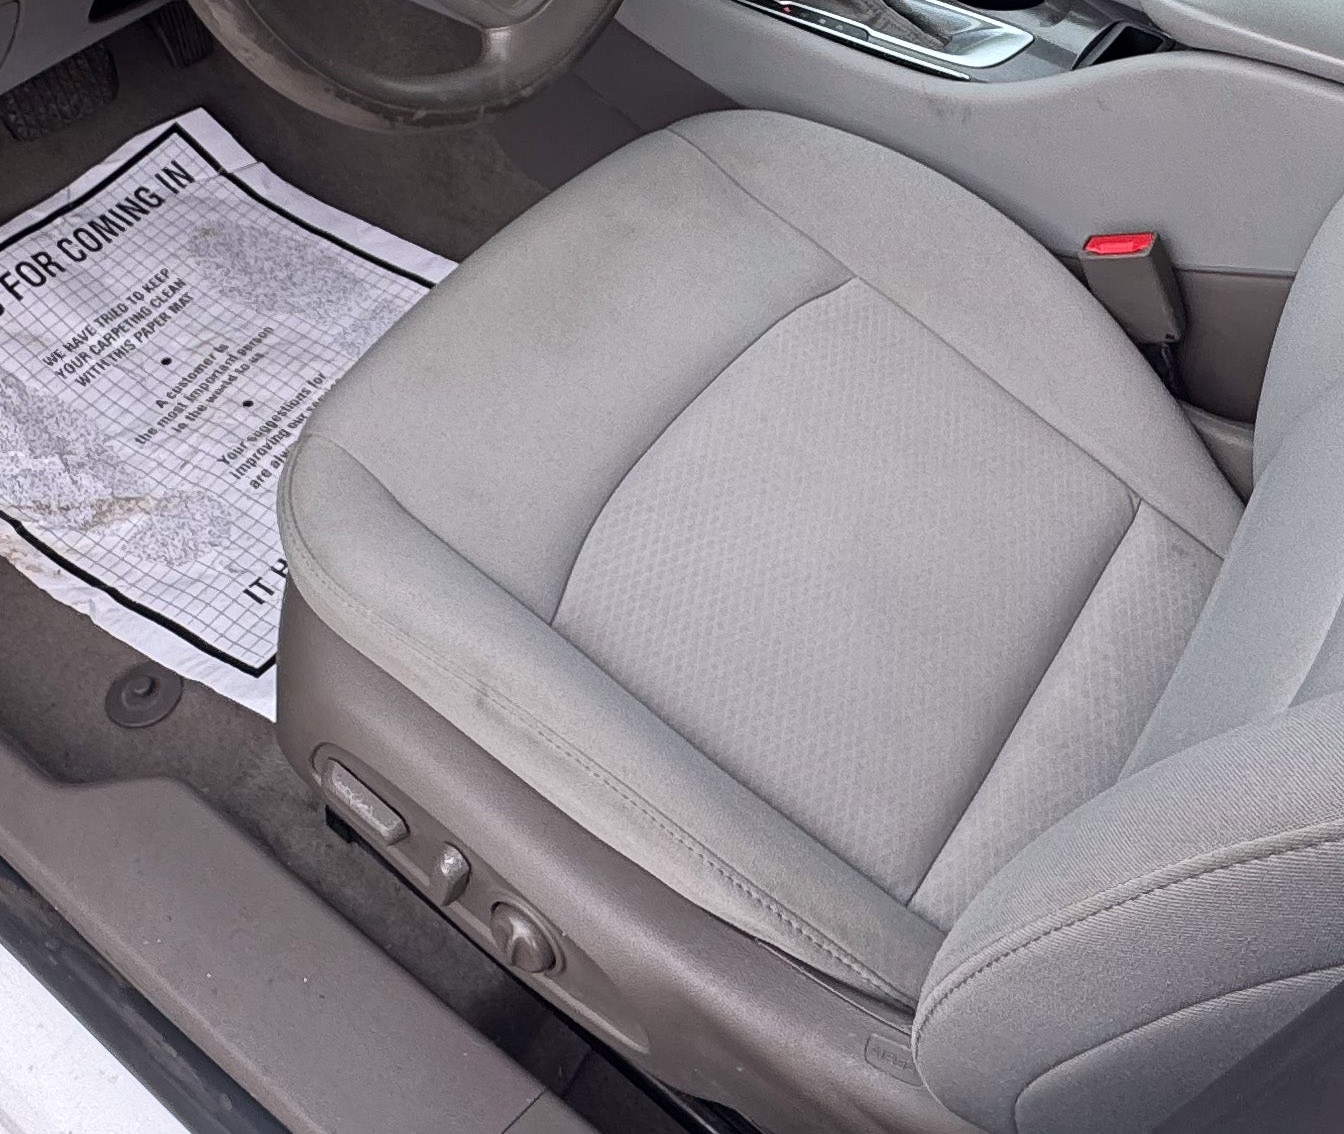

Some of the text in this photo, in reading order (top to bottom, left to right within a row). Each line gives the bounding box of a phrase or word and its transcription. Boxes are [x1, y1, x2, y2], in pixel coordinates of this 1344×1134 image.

[57, 186, 165, 262] COMING
[154, 160, 195, 194] IN
[42, 267, 170, 367] WE HAVE TRIED TO KEEP
[56, 277, 187, 379] YOUR CARPETING CLEAN
[75, 358, 111, 387] WITH
[107, 338, 136, 363] THIS
[133, 311, 172, 343] PAPER
[156, 399, 169, 409] A
[166, 353, 217, 399] customer
[135, 427, 158, 445] the
[157, 402, 187, 428] most
[185, 404, 207, 422] the
[217, 441, 249, 466] Your
[246, 387, 312, 443] suggestions
[306, 372, 327, 389] for
[287, 403, 308, 429] our
[249, 448, 290, 490] are alw
[242, 576, 275, 605] IT
